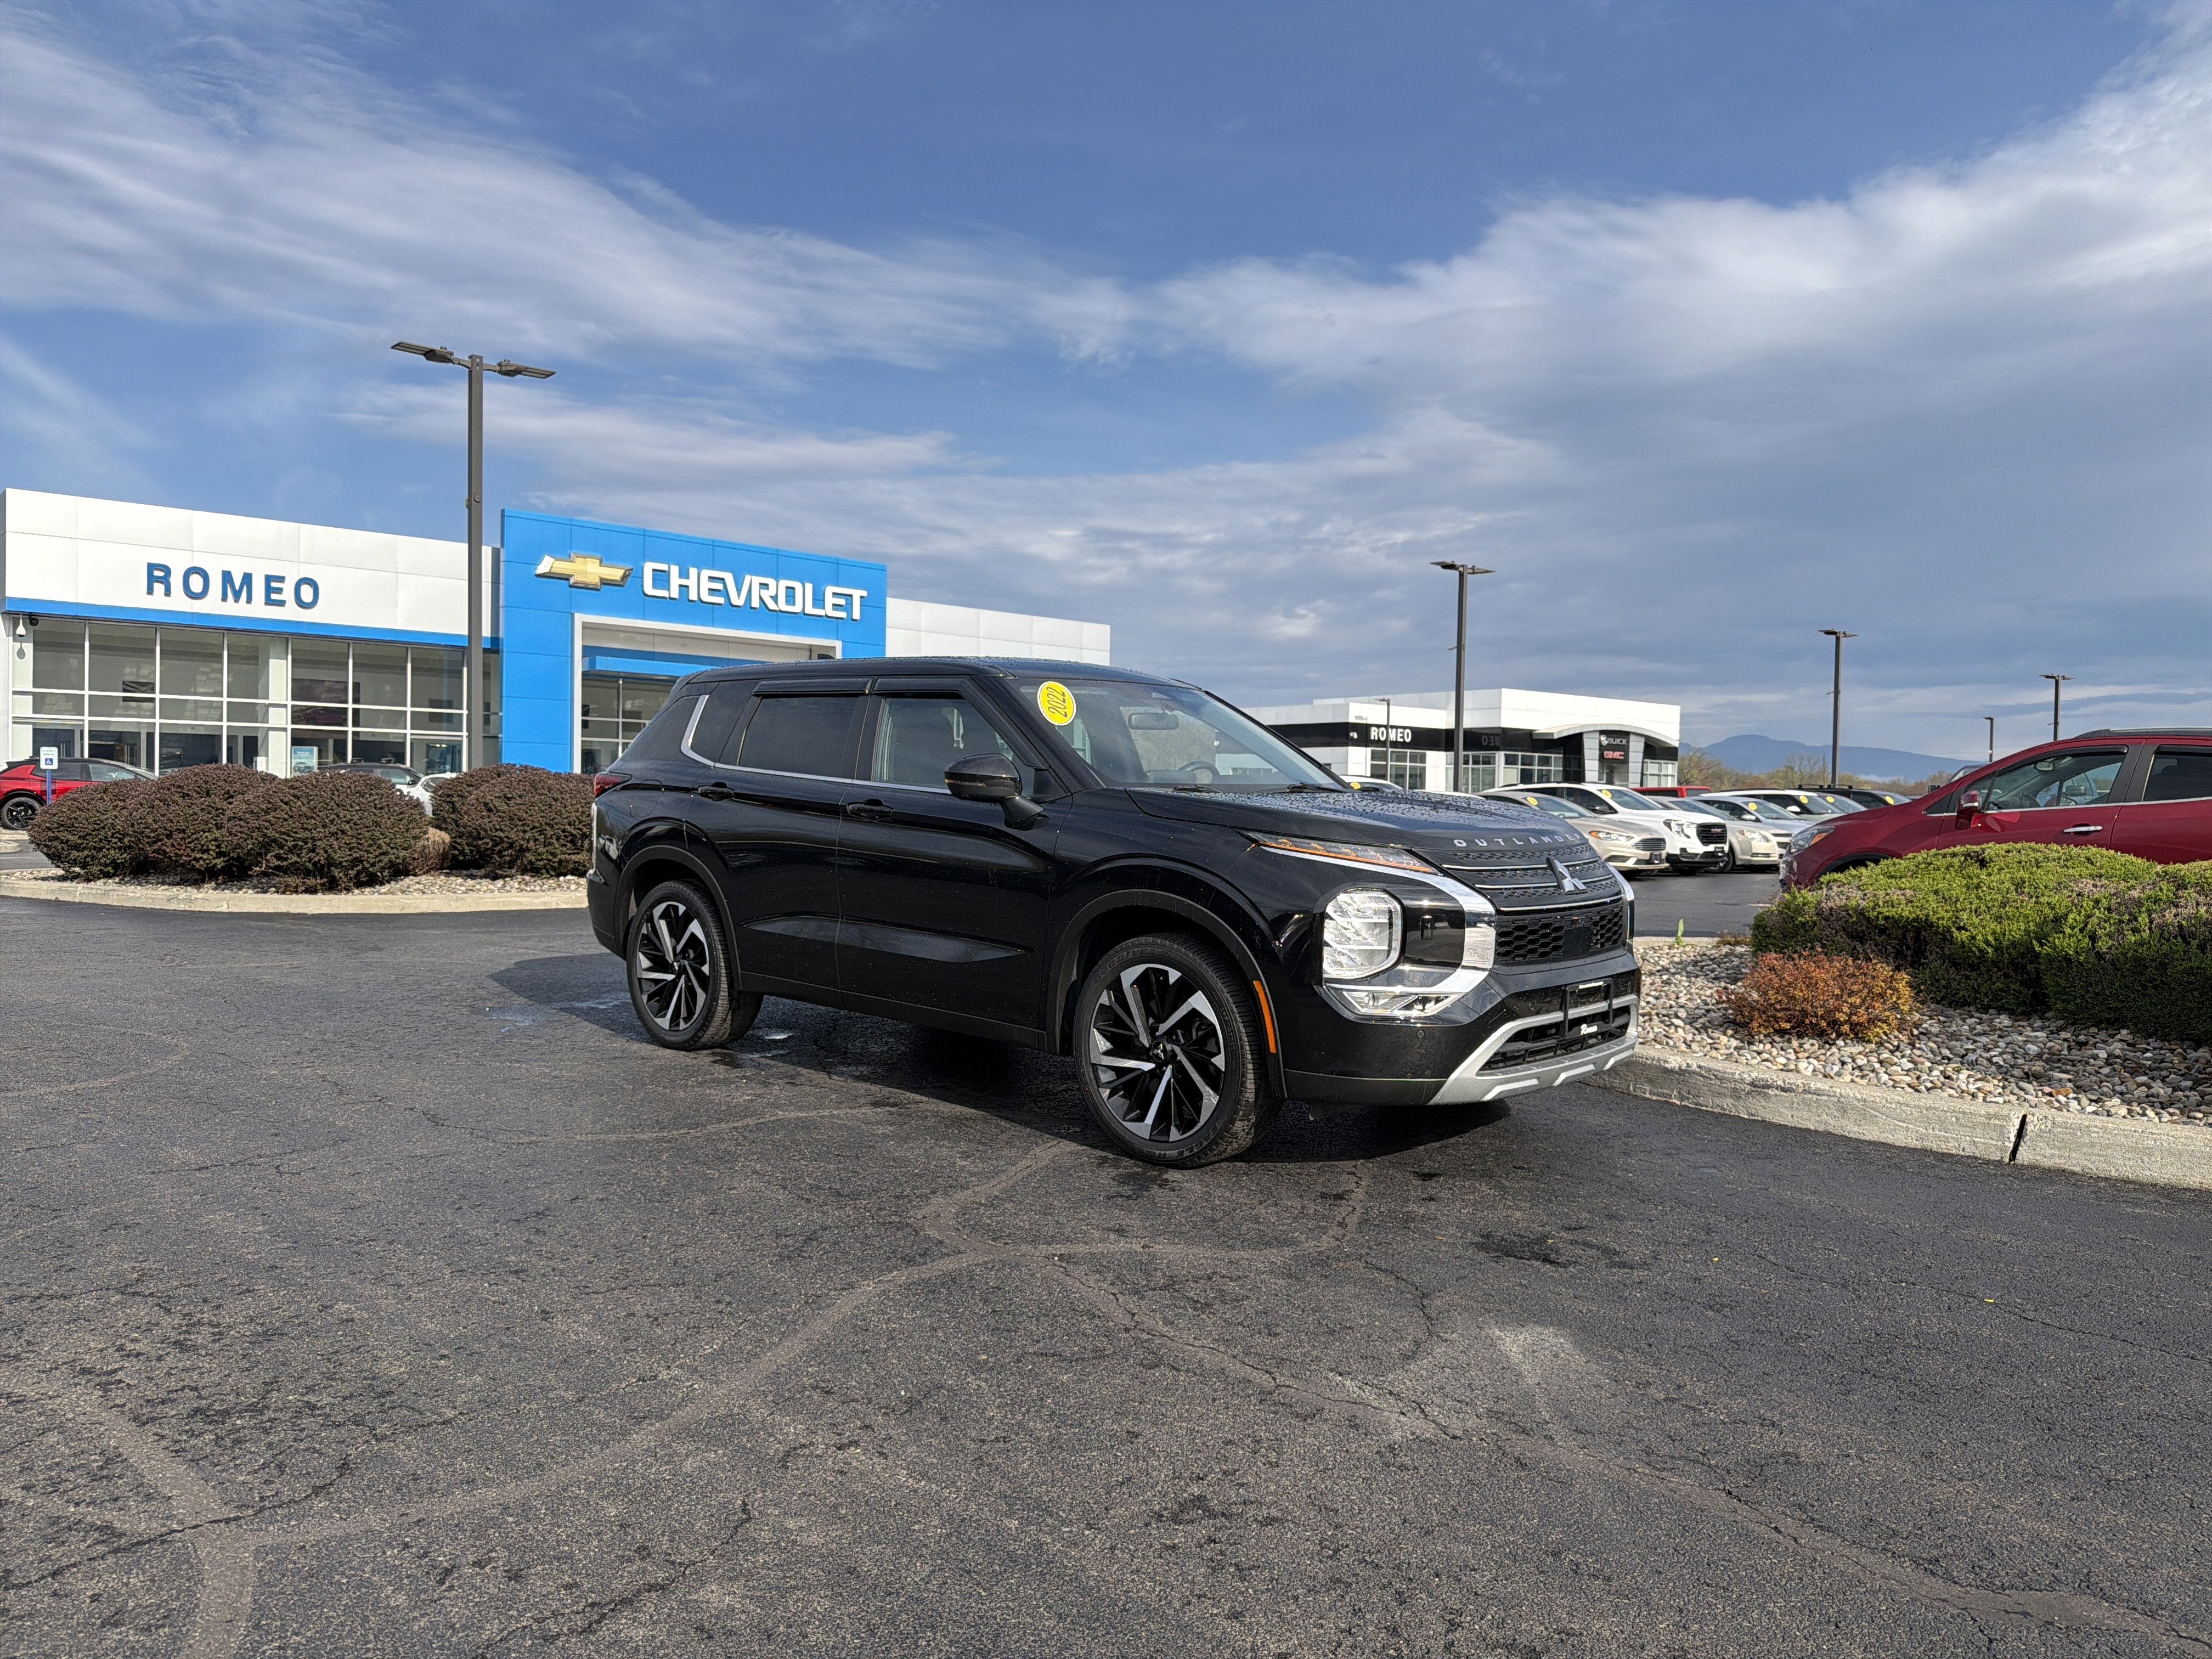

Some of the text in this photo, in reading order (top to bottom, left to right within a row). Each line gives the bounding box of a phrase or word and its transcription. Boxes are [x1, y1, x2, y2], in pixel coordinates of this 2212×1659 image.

[146, 562, 319, 610] ROMEO
[643, 562, 867, 622] CHEVROLET
[1046, 687, 1068, 718] 2022
[1370, 727, 1412, 742] ROMEO
[1604, 751, 1624, 759] GMC
[1453, 833, 1582, 848] OUTLANDER
